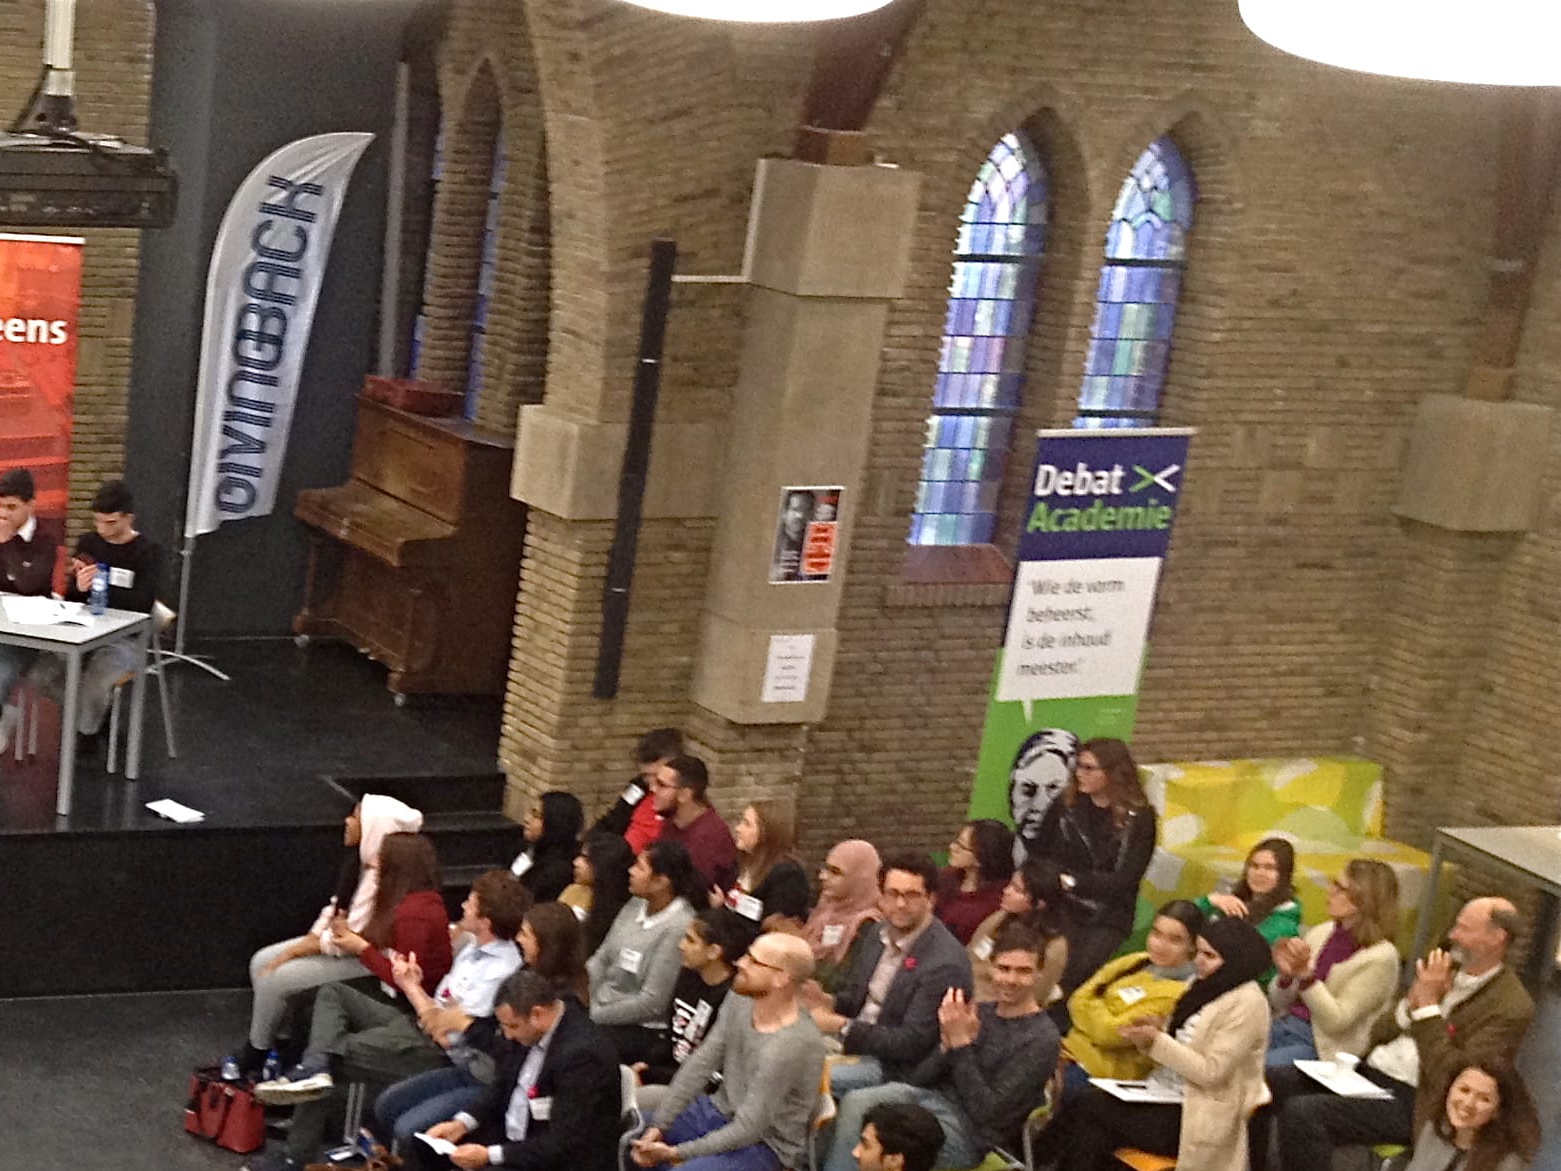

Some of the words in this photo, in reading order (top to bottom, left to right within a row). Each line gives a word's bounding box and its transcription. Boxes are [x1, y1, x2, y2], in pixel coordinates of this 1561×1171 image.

[1033, 462, 1126, 496] Debat
[1026, 498, 1172, 533] Academie
[1064, 577, 1083, 595] de
[1087, 579, 1126, 594] vorm
[1037, 632, 1057, 650] de
[1059, 629, 1112, 648] inhoud
